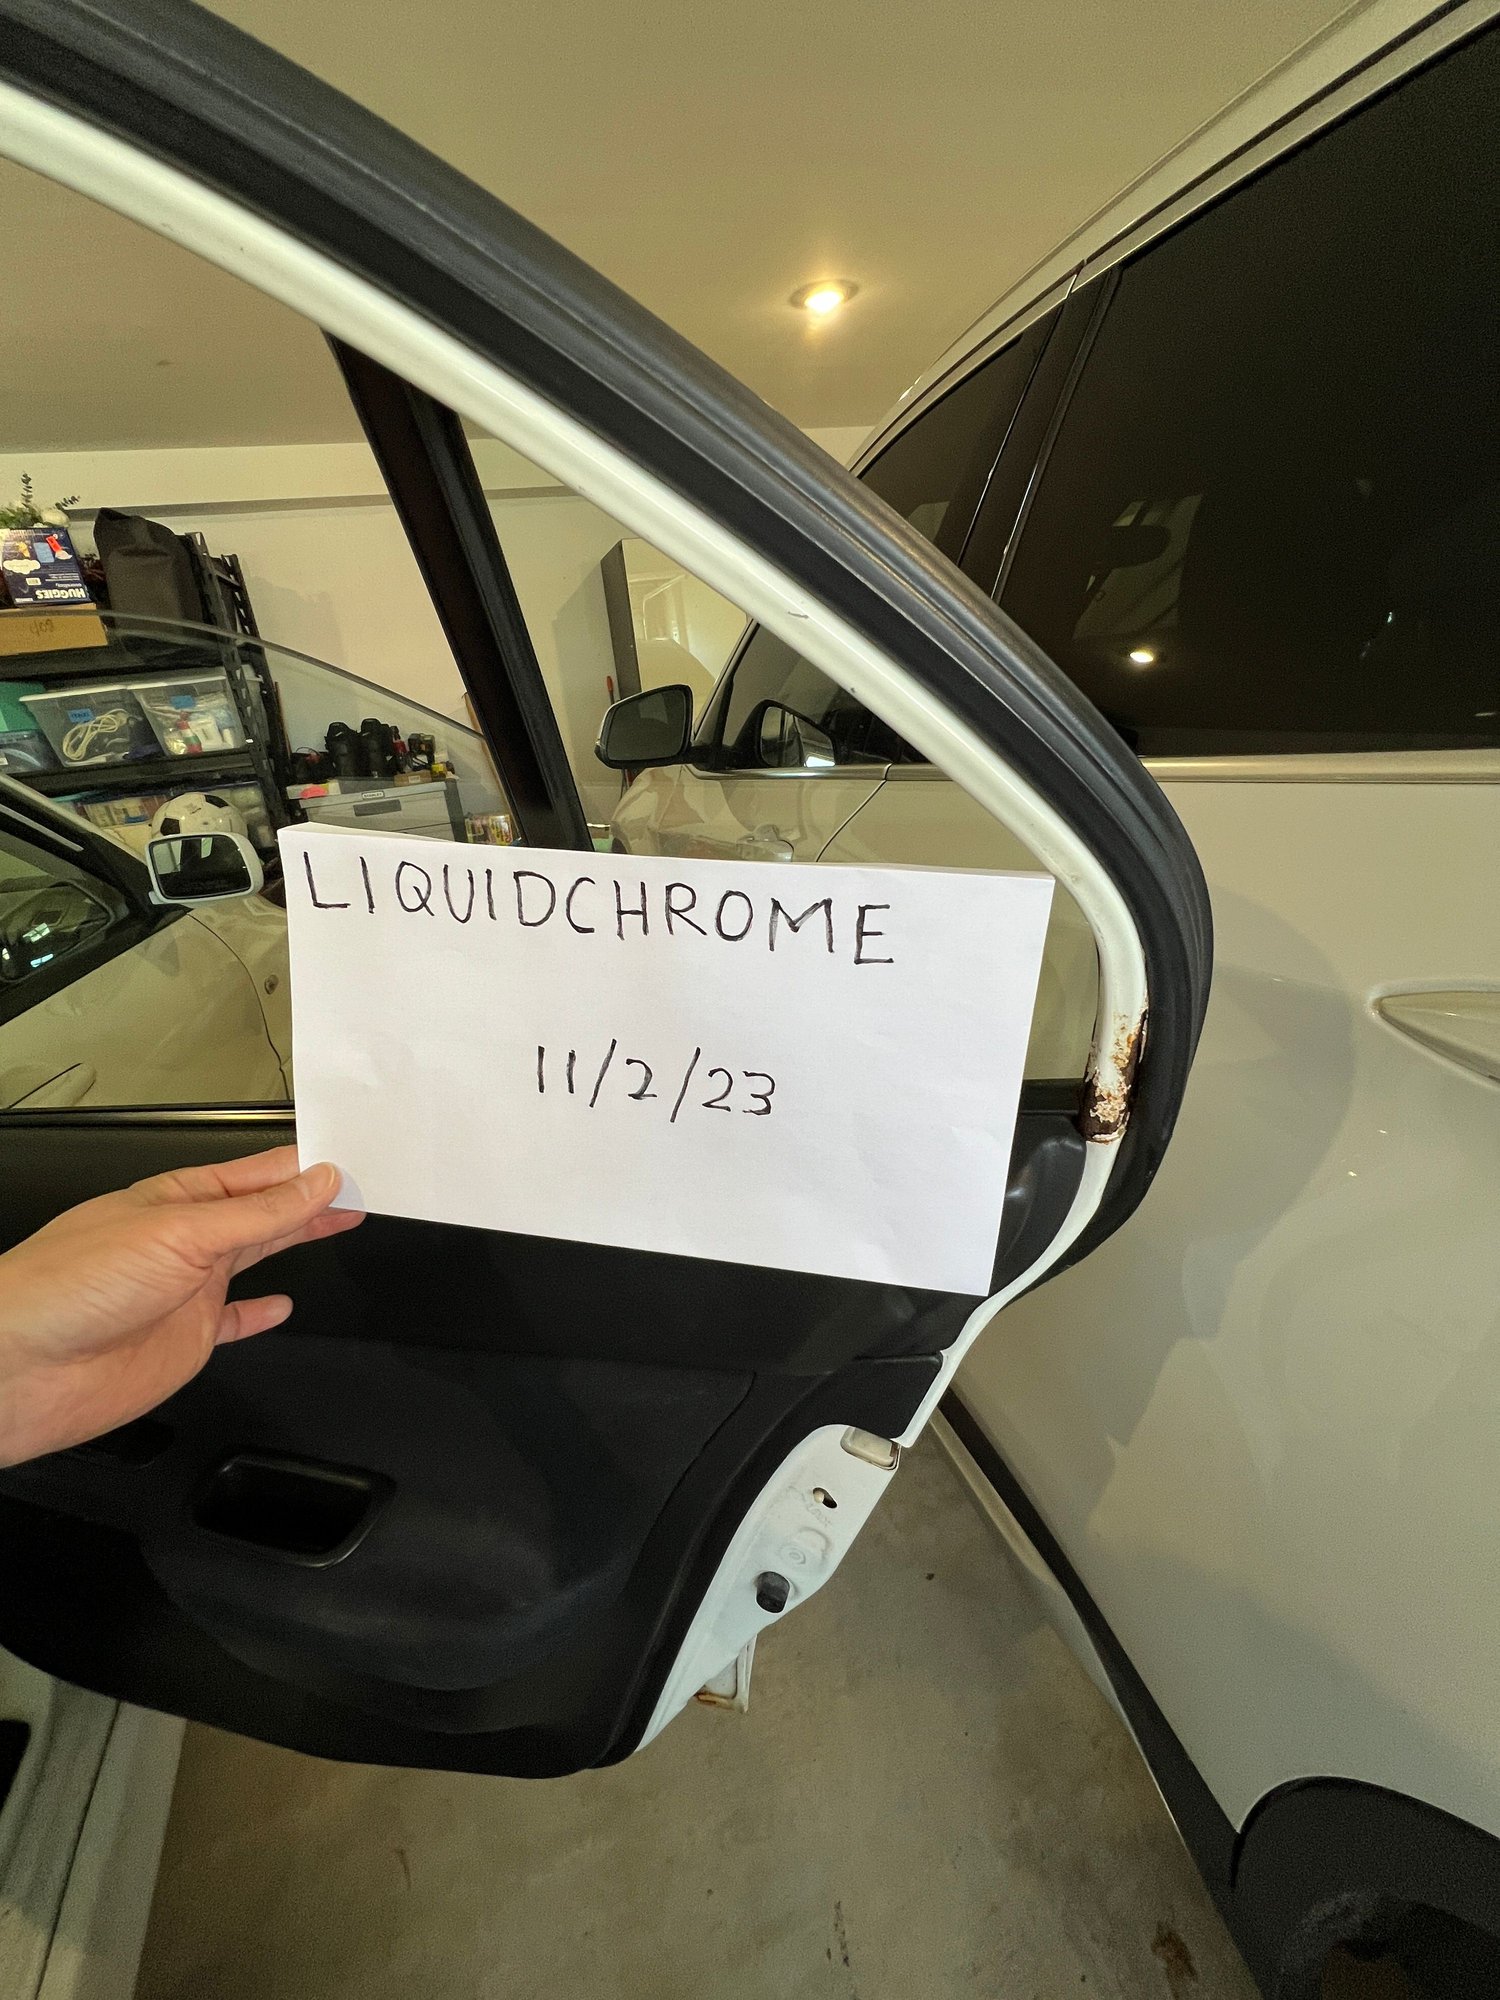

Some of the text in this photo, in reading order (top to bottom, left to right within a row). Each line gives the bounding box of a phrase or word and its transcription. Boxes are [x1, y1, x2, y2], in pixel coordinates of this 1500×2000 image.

[35, 588, 87, 599] HUGGIES
[303, 851, 895, 965] LIQUIDCHROME
[537, 1038, 776, 1123] 11/2/23
